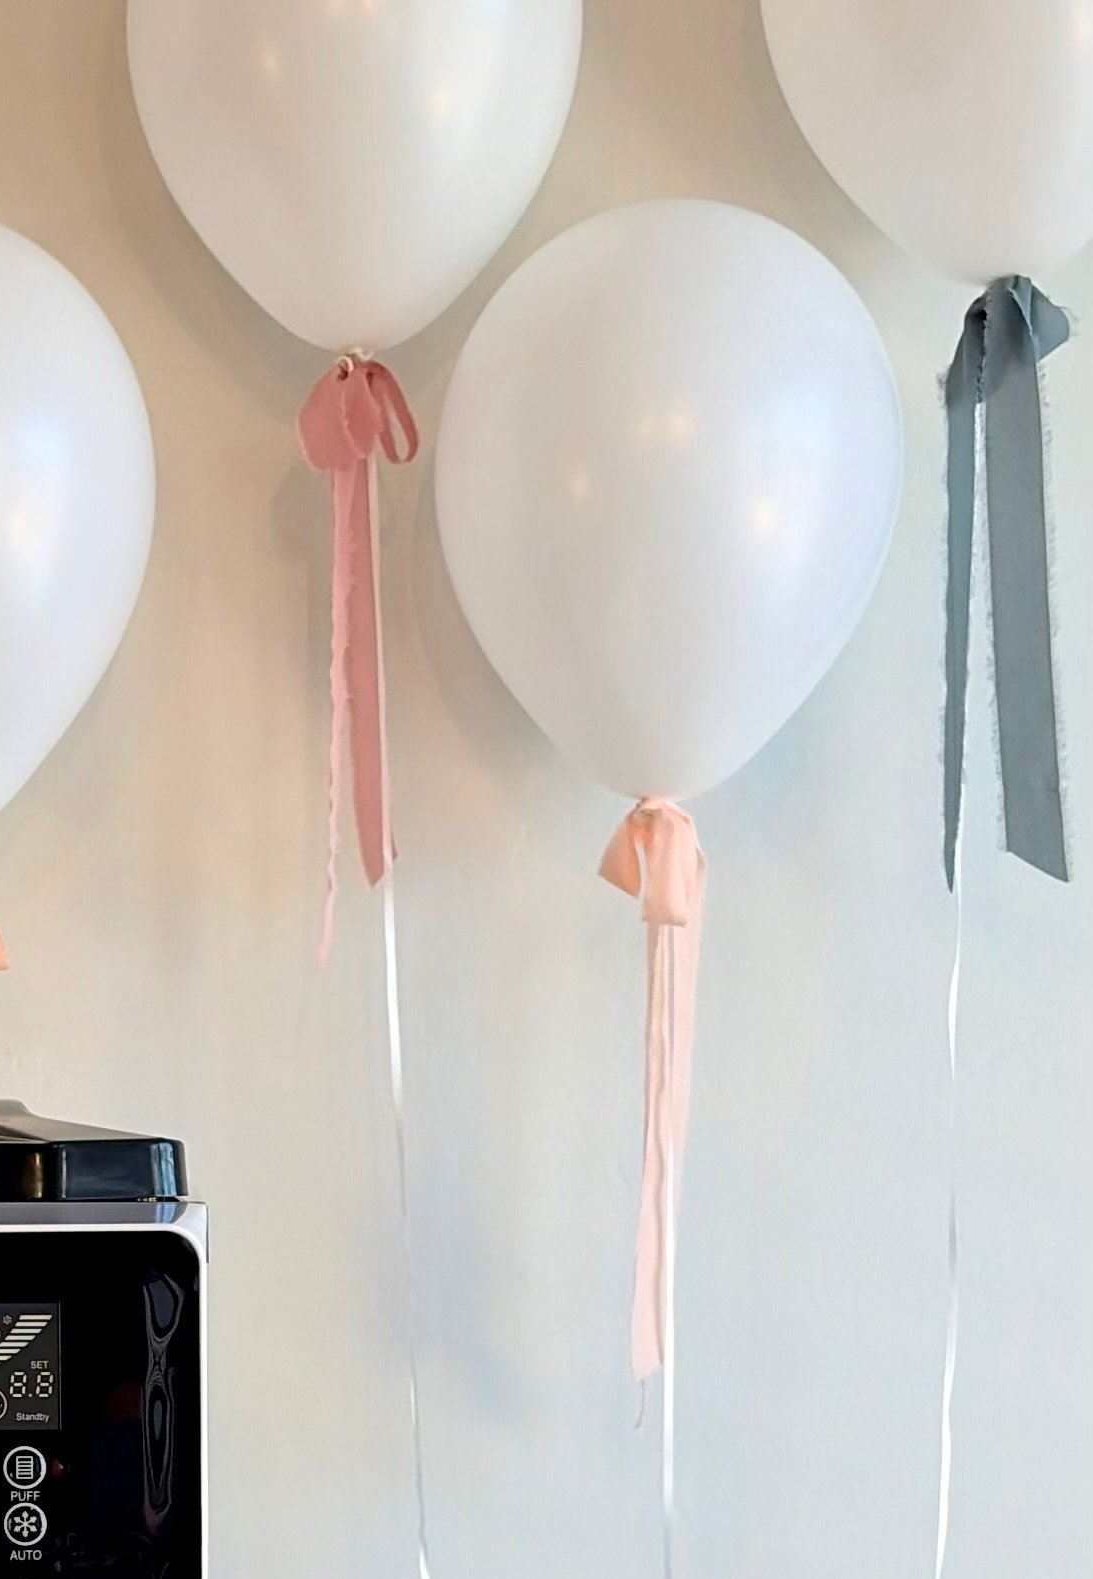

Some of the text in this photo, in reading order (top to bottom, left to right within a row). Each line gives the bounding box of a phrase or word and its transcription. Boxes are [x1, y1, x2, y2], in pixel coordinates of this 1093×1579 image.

[30, 1361, 49, 1370] SET
[15, 1412, 51, 1424] Standby
[10, 1490, 41, 1502] PUFF
[10, 1550, 42, 1561] AUTO
